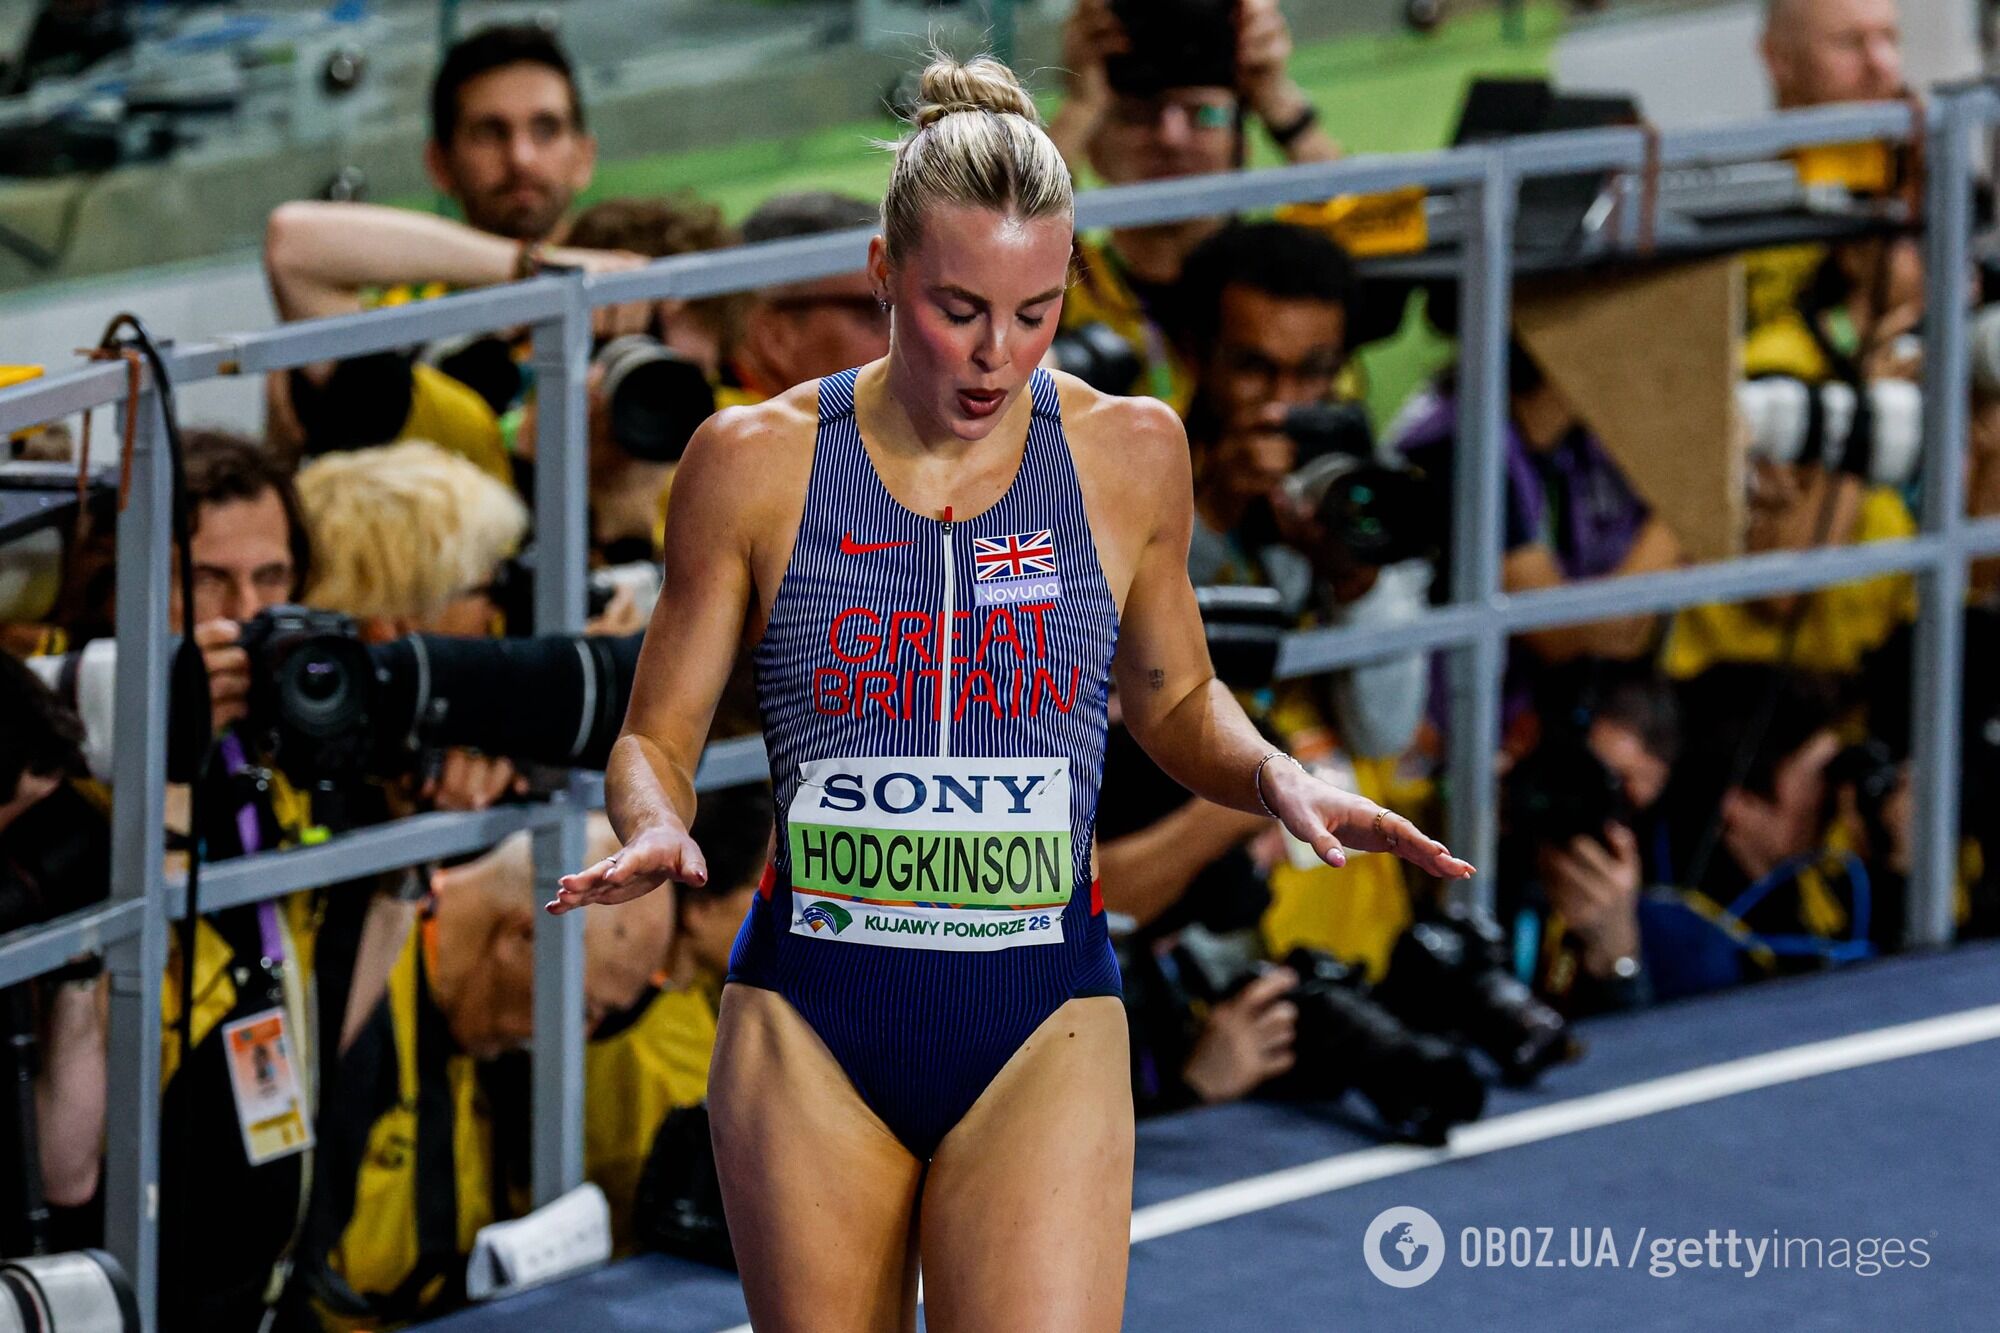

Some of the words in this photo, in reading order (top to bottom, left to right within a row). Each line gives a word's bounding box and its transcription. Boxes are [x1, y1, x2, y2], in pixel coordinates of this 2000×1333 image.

[975, 582, 1059, 604] Novuna
[828, 602, 1056, 665] GREAT
[813, 665, 1080, 722] BRITAIN
[819, 772, 1045, 815] SONY
[801, 829, 1061, 895] HODGKINSON
[864, 914, 940, 937] KUJAWY
[943, 917, 1026, 938] POMORZE
[1028, 914, 1051, 932] 26
